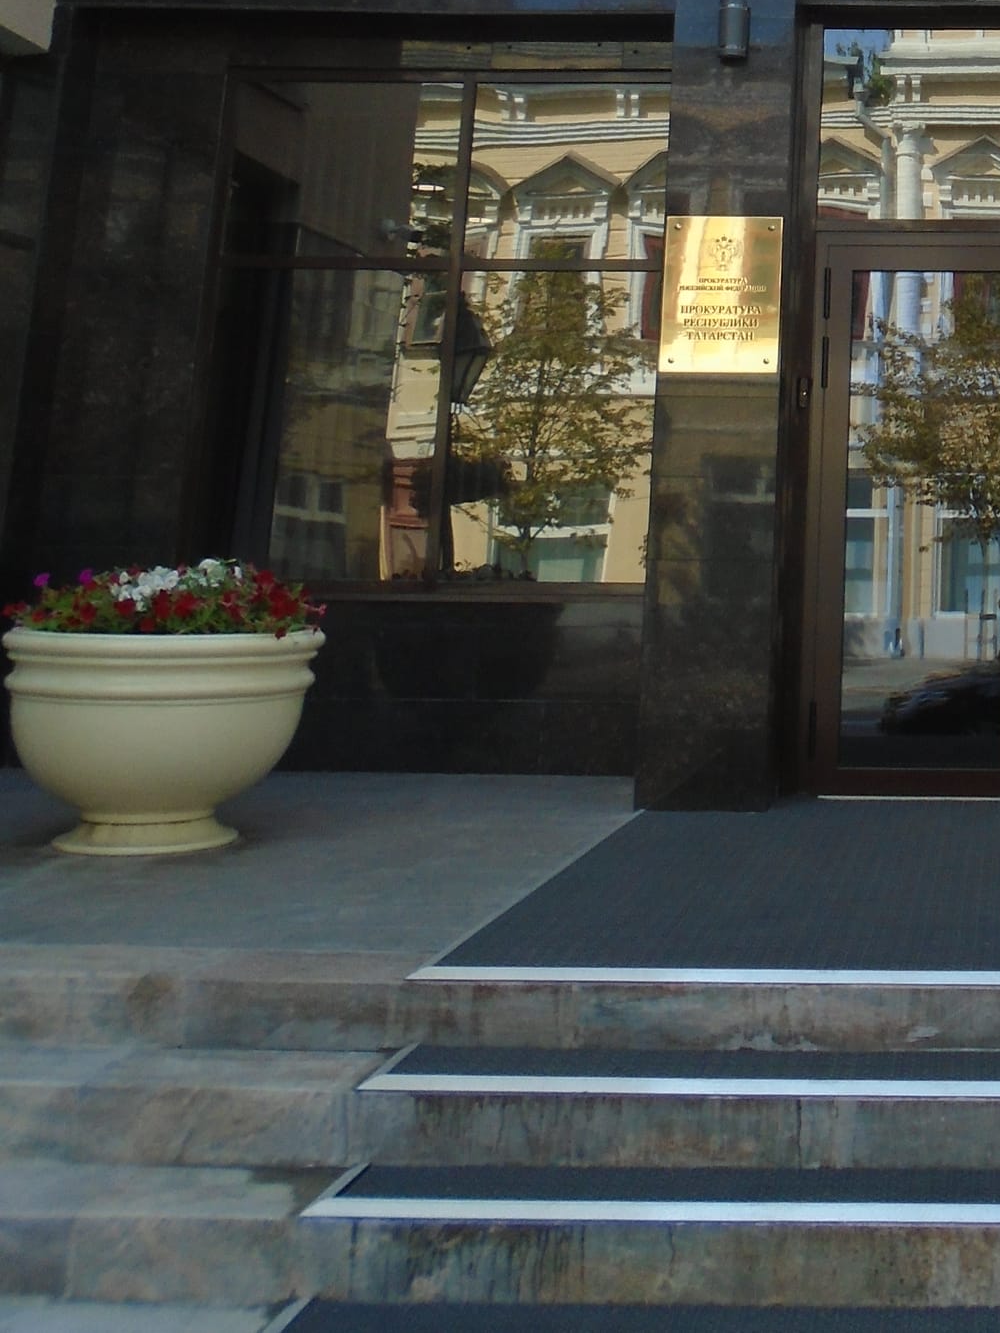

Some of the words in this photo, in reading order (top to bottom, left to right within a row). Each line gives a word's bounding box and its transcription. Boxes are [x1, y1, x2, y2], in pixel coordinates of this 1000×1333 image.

[680, 305, 761, 315] ПРОКУРАТУРА
[683, 319, 758, 329] РЕСПУБЛИКИ
[688, 331, 753, 341] ТАТАРСТАН
